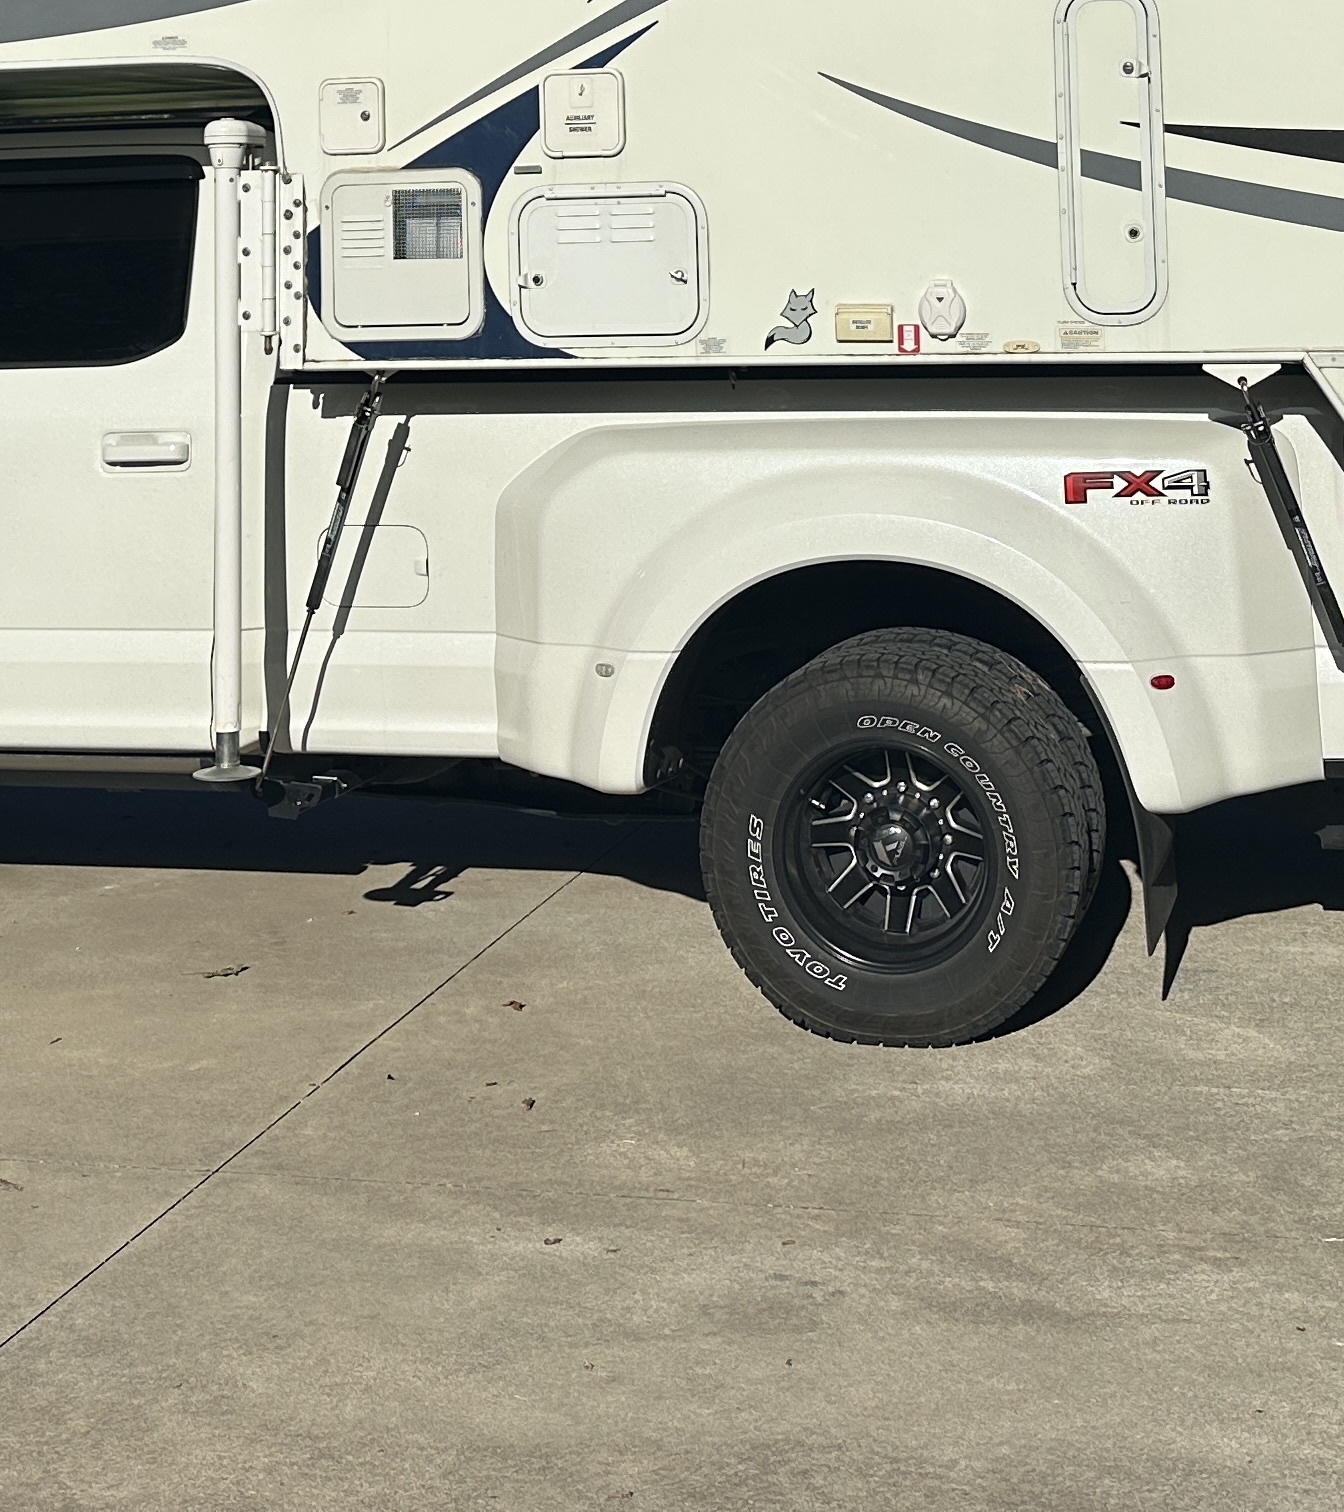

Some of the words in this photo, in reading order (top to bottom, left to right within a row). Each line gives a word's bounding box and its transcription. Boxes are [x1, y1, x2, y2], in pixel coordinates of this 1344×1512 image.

[1063, 469, 1210, 504] FX4
[747, 814, 778, 923] TIRES
[856, 715, 942, 742] OPEN
[944, 742, 1020, 879] COUNTRY
[988, 887, 1016, 953] A/T
[772, 925, 848, 990] TOYO
